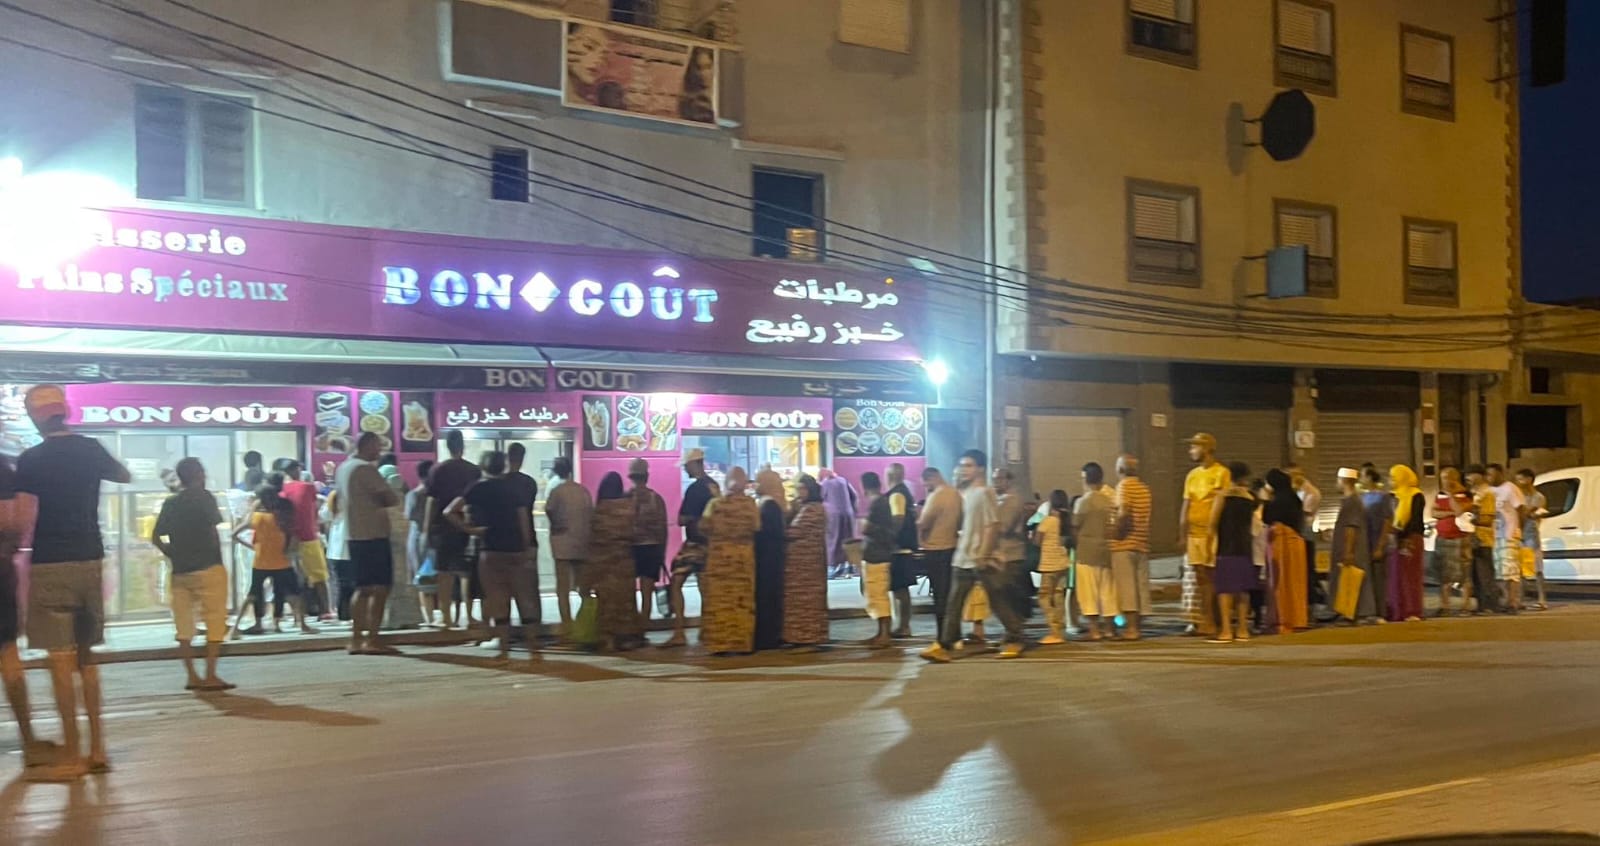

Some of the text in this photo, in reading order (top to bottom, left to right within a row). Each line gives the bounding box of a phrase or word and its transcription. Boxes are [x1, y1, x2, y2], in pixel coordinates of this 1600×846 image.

[130, 266, 289, 302] Spéciaux
[382, 265, 719, 324] BON GOÛT
[773, 278, 899, 309] مرطبات
[745, 313, 904, 345] خبز رفيع
[484, 368, 636, 390] BON GOUT
[80, 402, 297, 424] BON GOÛT
[446, 405, 569, 426] مرطبات خبز رفيع
[691, 409, 824, 429] BON GOÛT
